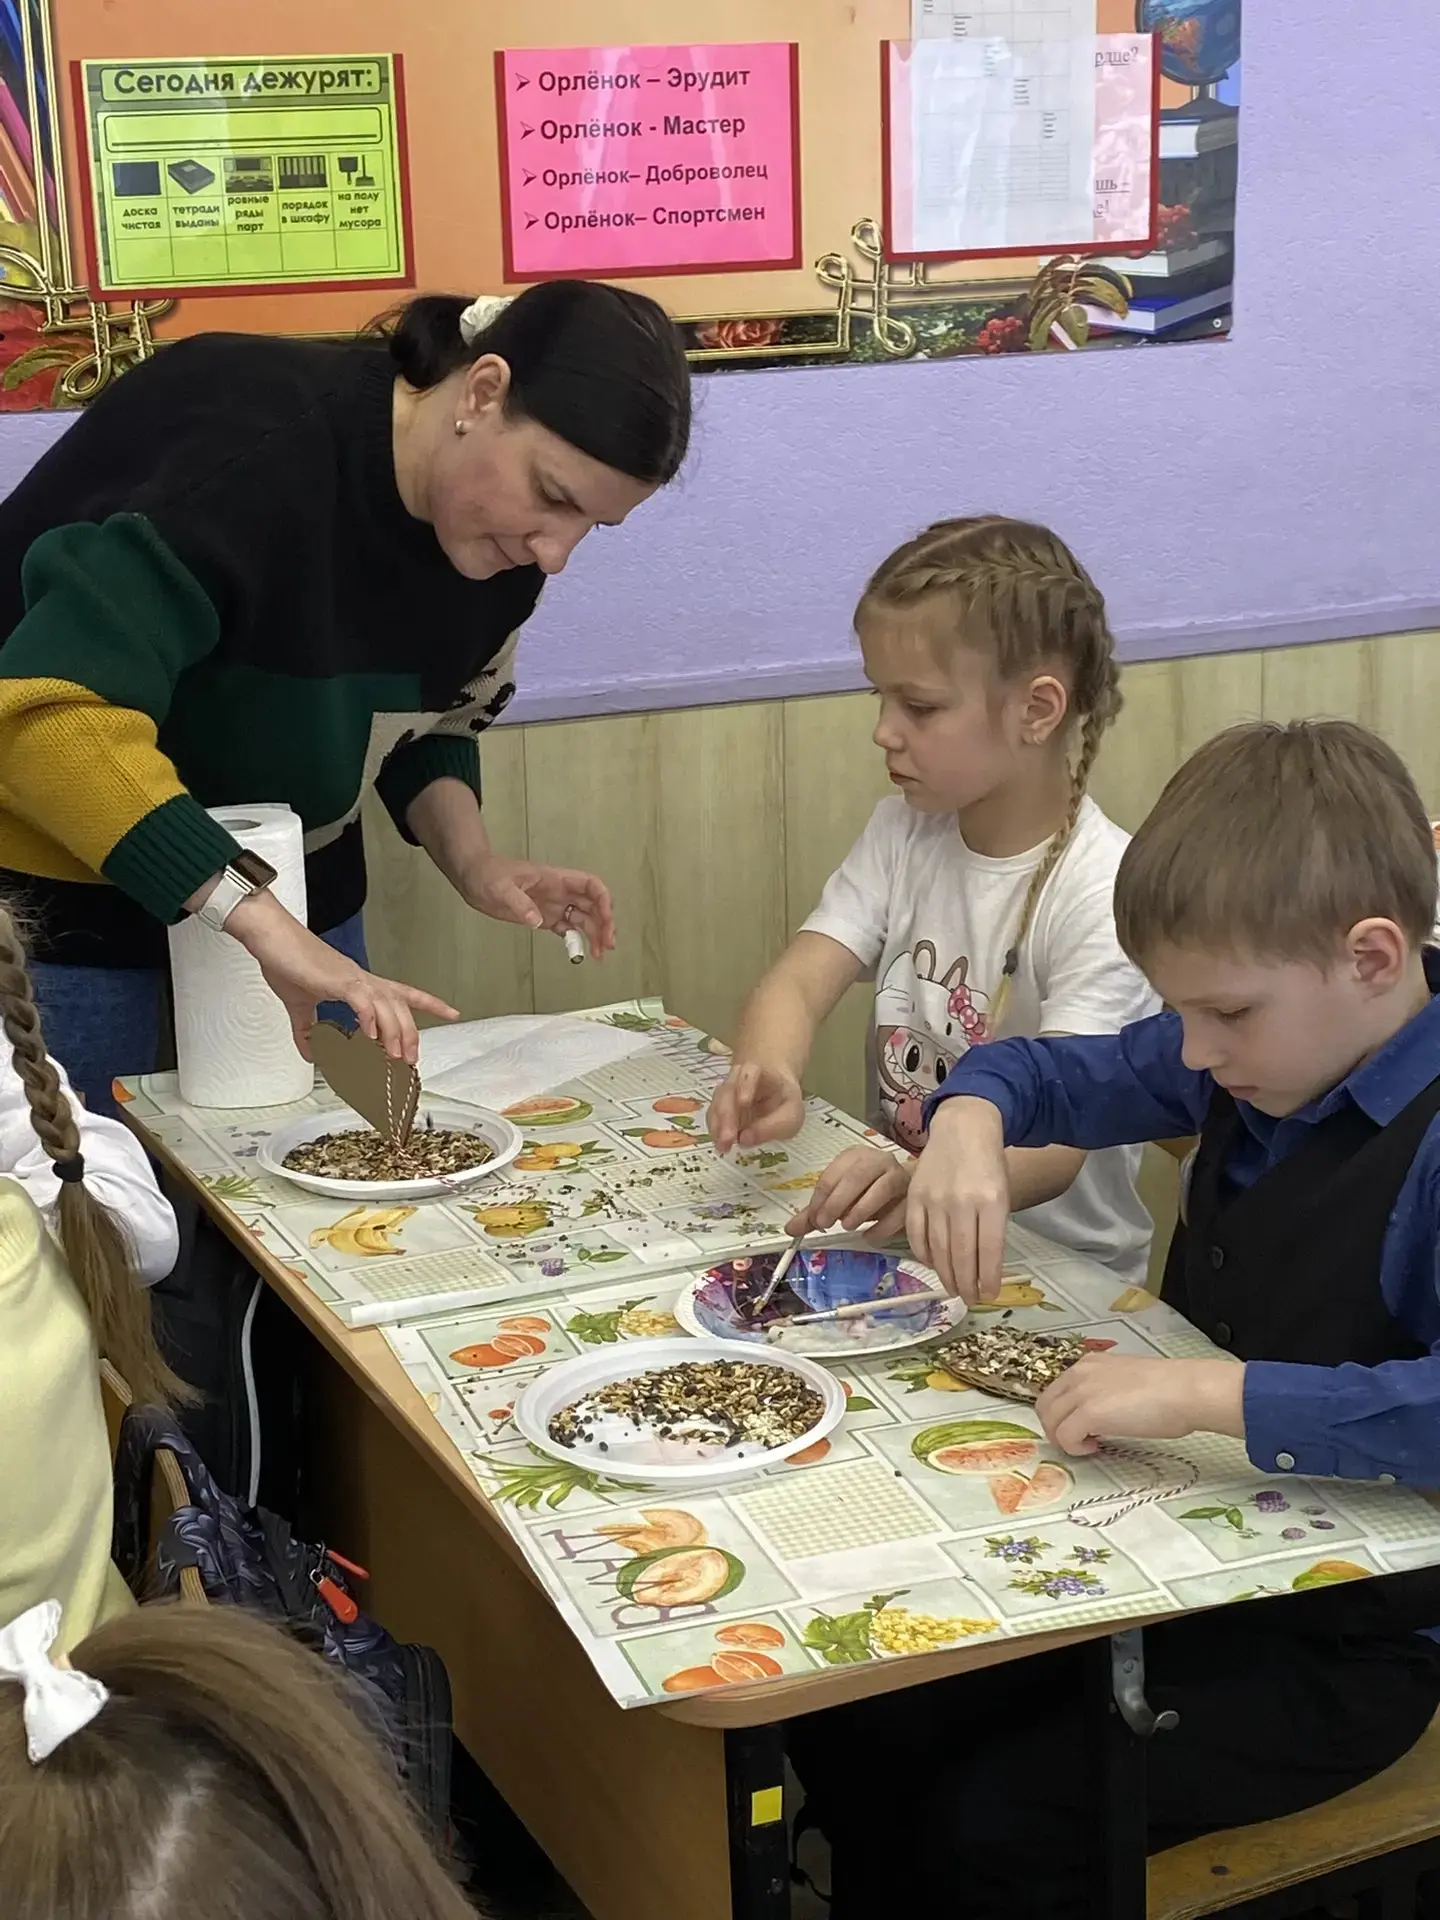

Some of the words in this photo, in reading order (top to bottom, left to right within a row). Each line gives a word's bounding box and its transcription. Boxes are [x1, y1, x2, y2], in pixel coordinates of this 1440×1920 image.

[114, 69, 234, 94] Сегодня
[243, 67, 373, 93] дежурят:
[538, 70, 641, 95] Орлёнок
[667, 68, 750, 92] Эрудит
[540, 119, 642, 143] Орлёнок
[663, 115, 745, 137] Мастер
[645, 164, 768, 185] Доброволец
[228, 195, 269, 206] ровные
[337, 193, 351, 202] на
[354, 191, 379, 202] полу
[172, 204, 220, 215] тетради
[282, 200, 328, 211] порядок
[350, 204, 369, 214] нет
[122, 206, 158, 217] доска
[235, 208, 264, 219] ряды
[652, 206, 765, 227] Спортсмен
[175, 217, 220, 229] выданы
[281, 216, 288, 224] в
[290, 212, 330, 225] шкафу
[339, 217, 381, 229] мусора
[121, 220, 161, 230] чистая
[236, 222, 264, 232] парт
